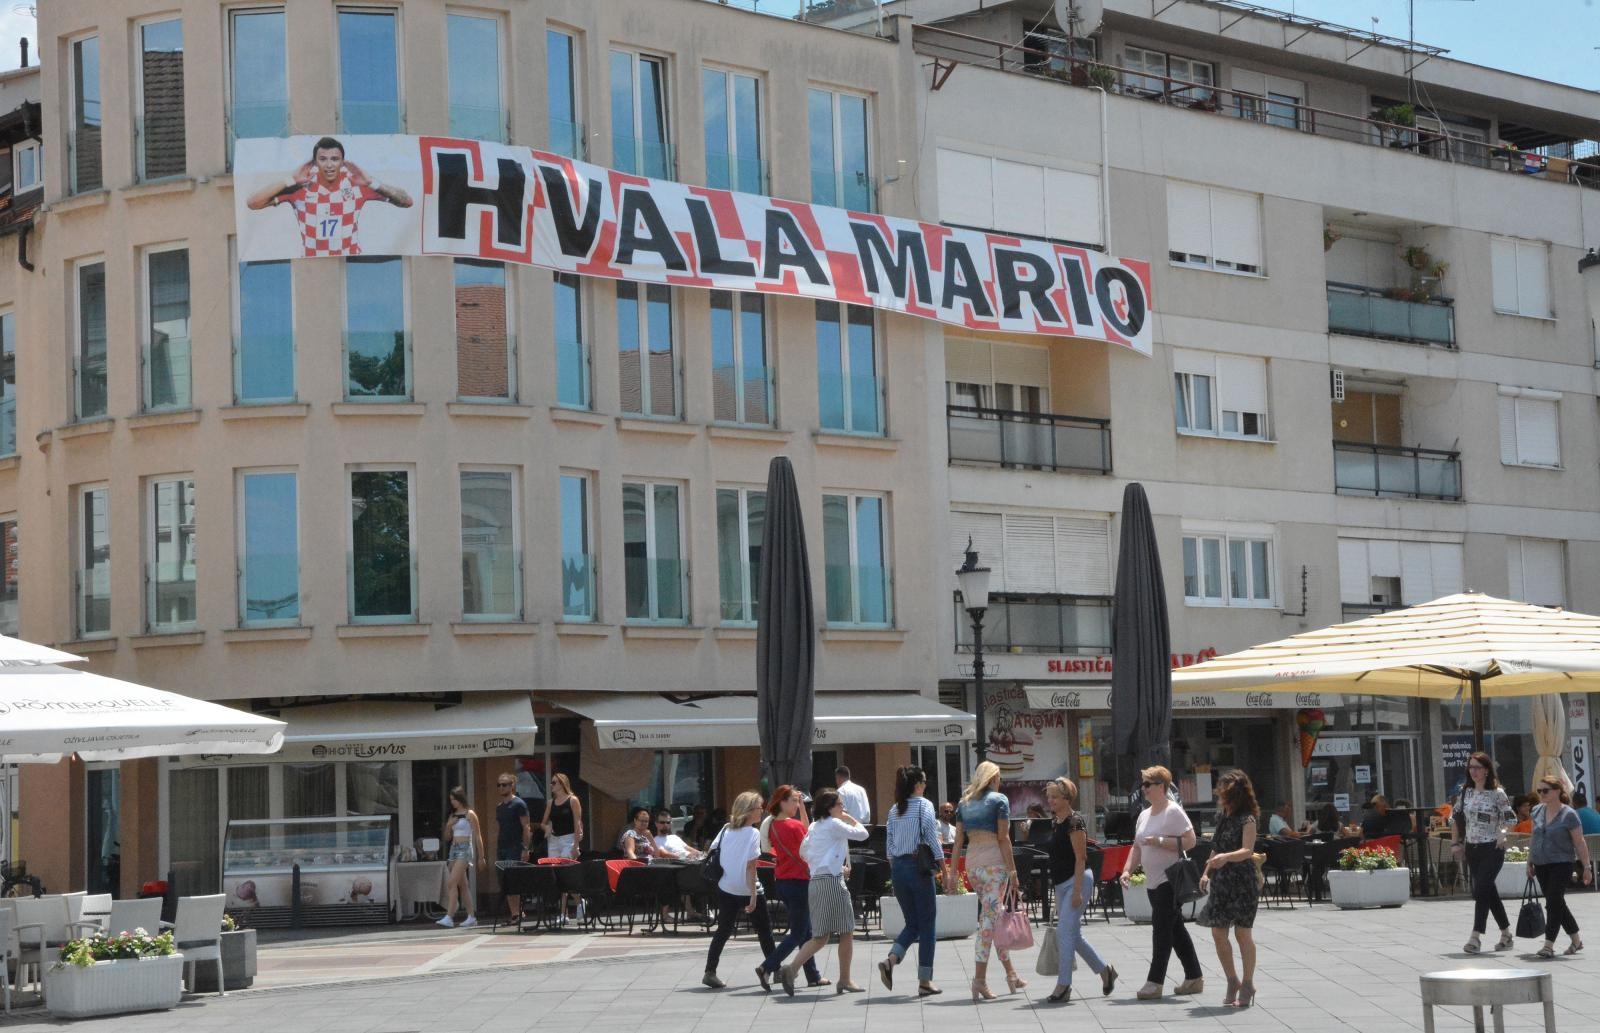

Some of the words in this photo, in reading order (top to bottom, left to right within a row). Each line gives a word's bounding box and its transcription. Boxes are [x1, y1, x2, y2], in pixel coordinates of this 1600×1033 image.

[320, 219, 339, 237] 17
[437, 152, 831, 286] HVALA
[849, 221, 1146, 338] MARIO
[1190, 695, 1217, 707] AROMA
